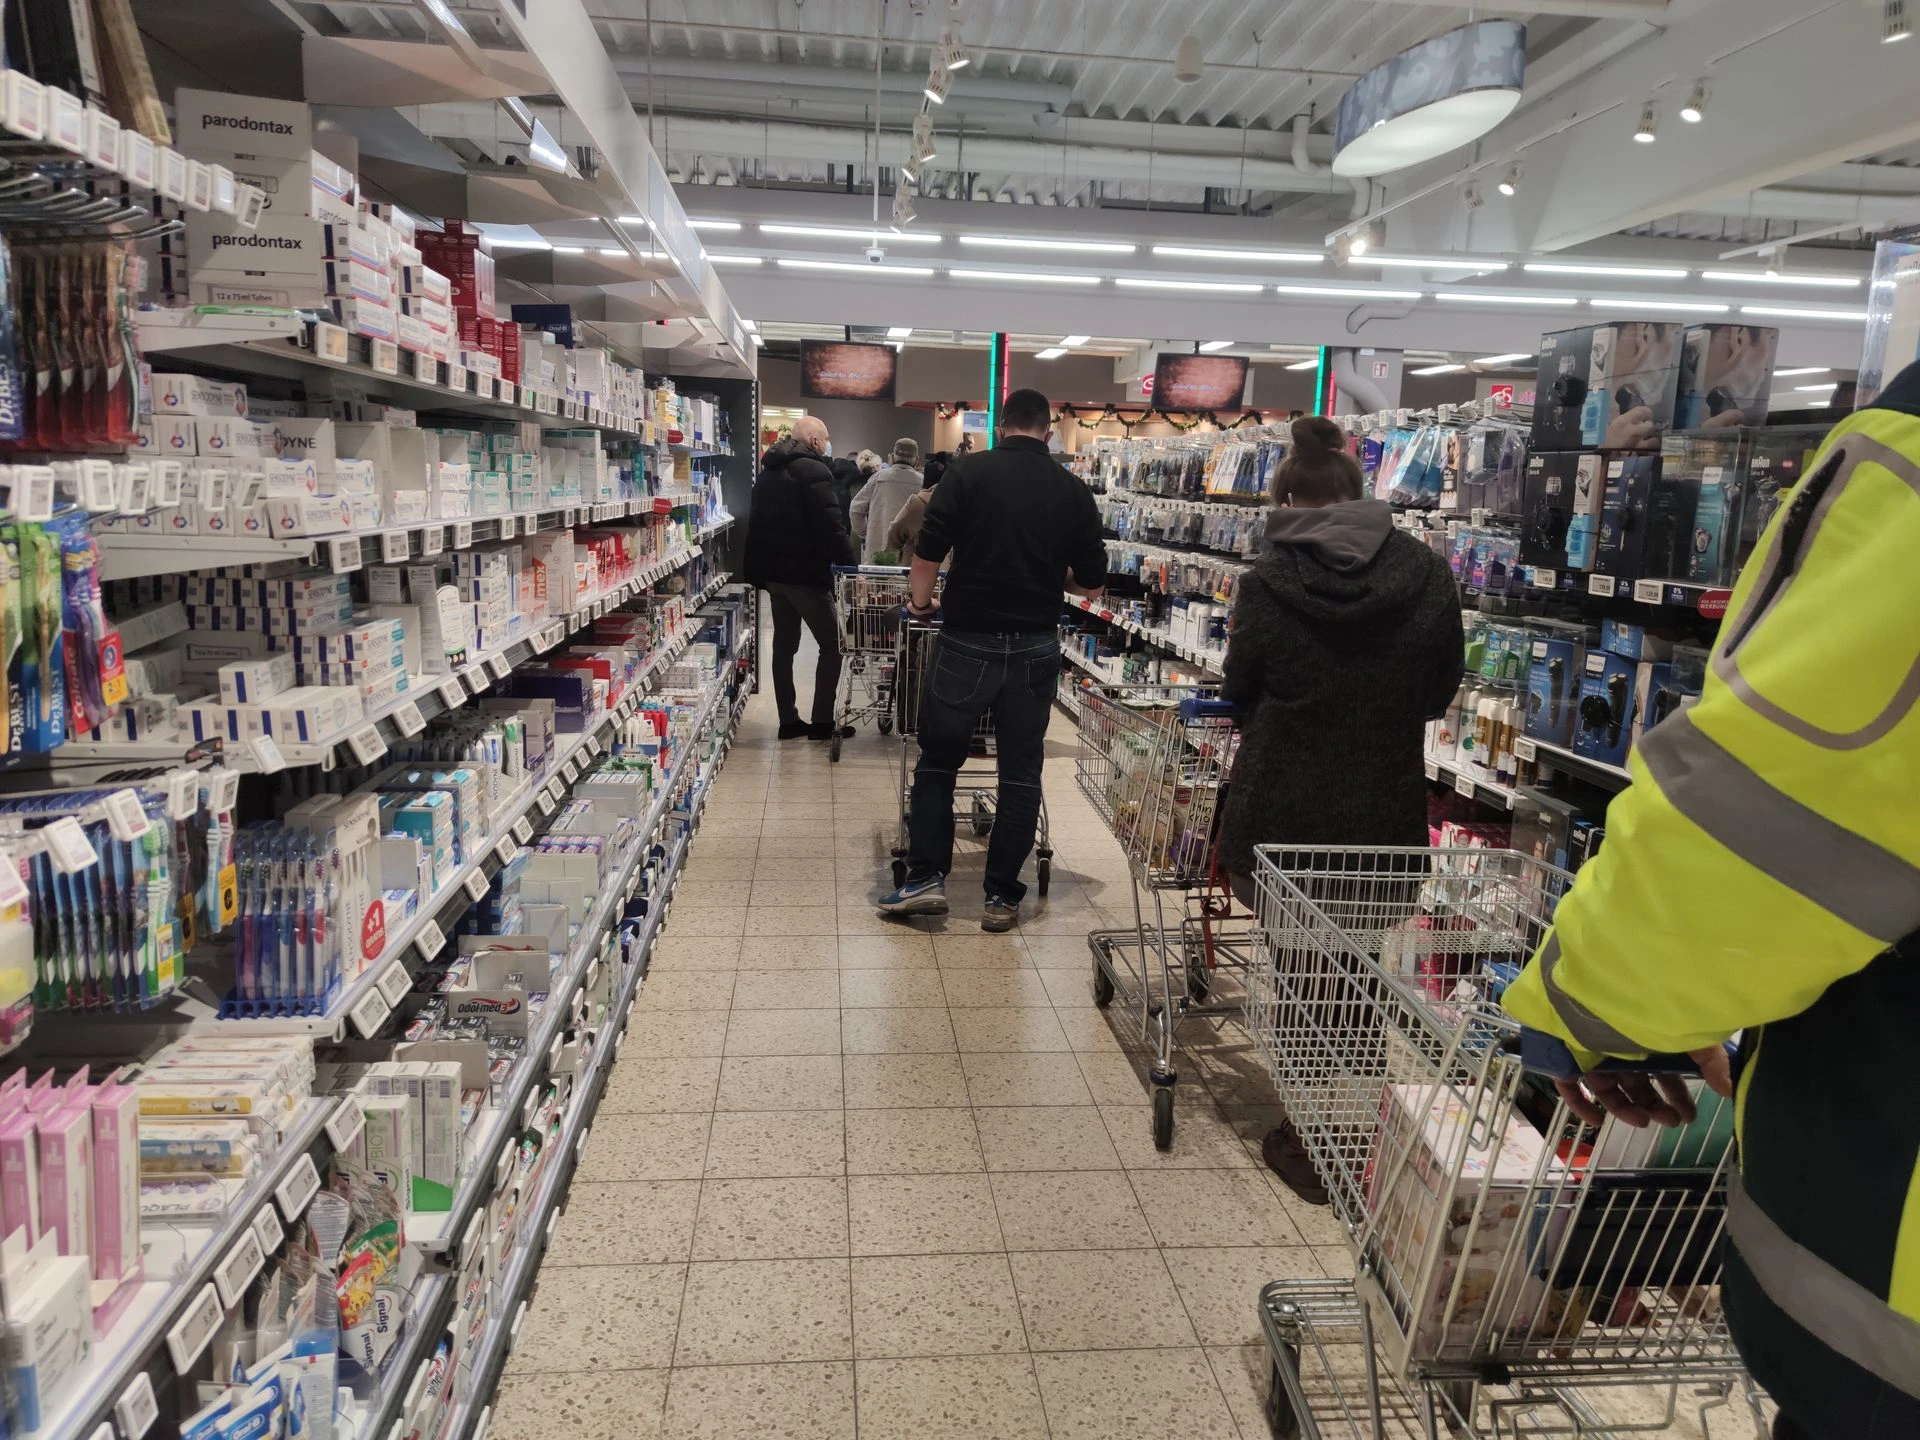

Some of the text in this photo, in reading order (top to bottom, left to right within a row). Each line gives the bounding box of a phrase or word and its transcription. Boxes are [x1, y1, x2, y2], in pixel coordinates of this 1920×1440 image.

[202, 113, 294, 135] parodontax
[212, 233, 303, 250] parodontax
[1751, 455, 1770, 468] BRAUN
[10, 682, 21, 752] Dr.BEST
[366, 907, 381, 931] +1
[365, 927, 385, 948] GRATIS
[369, 1134, 385, 1159] BIO
[375, 1297, 390, 1335] Signal
[360, 1332, 376, 1370] Signal
